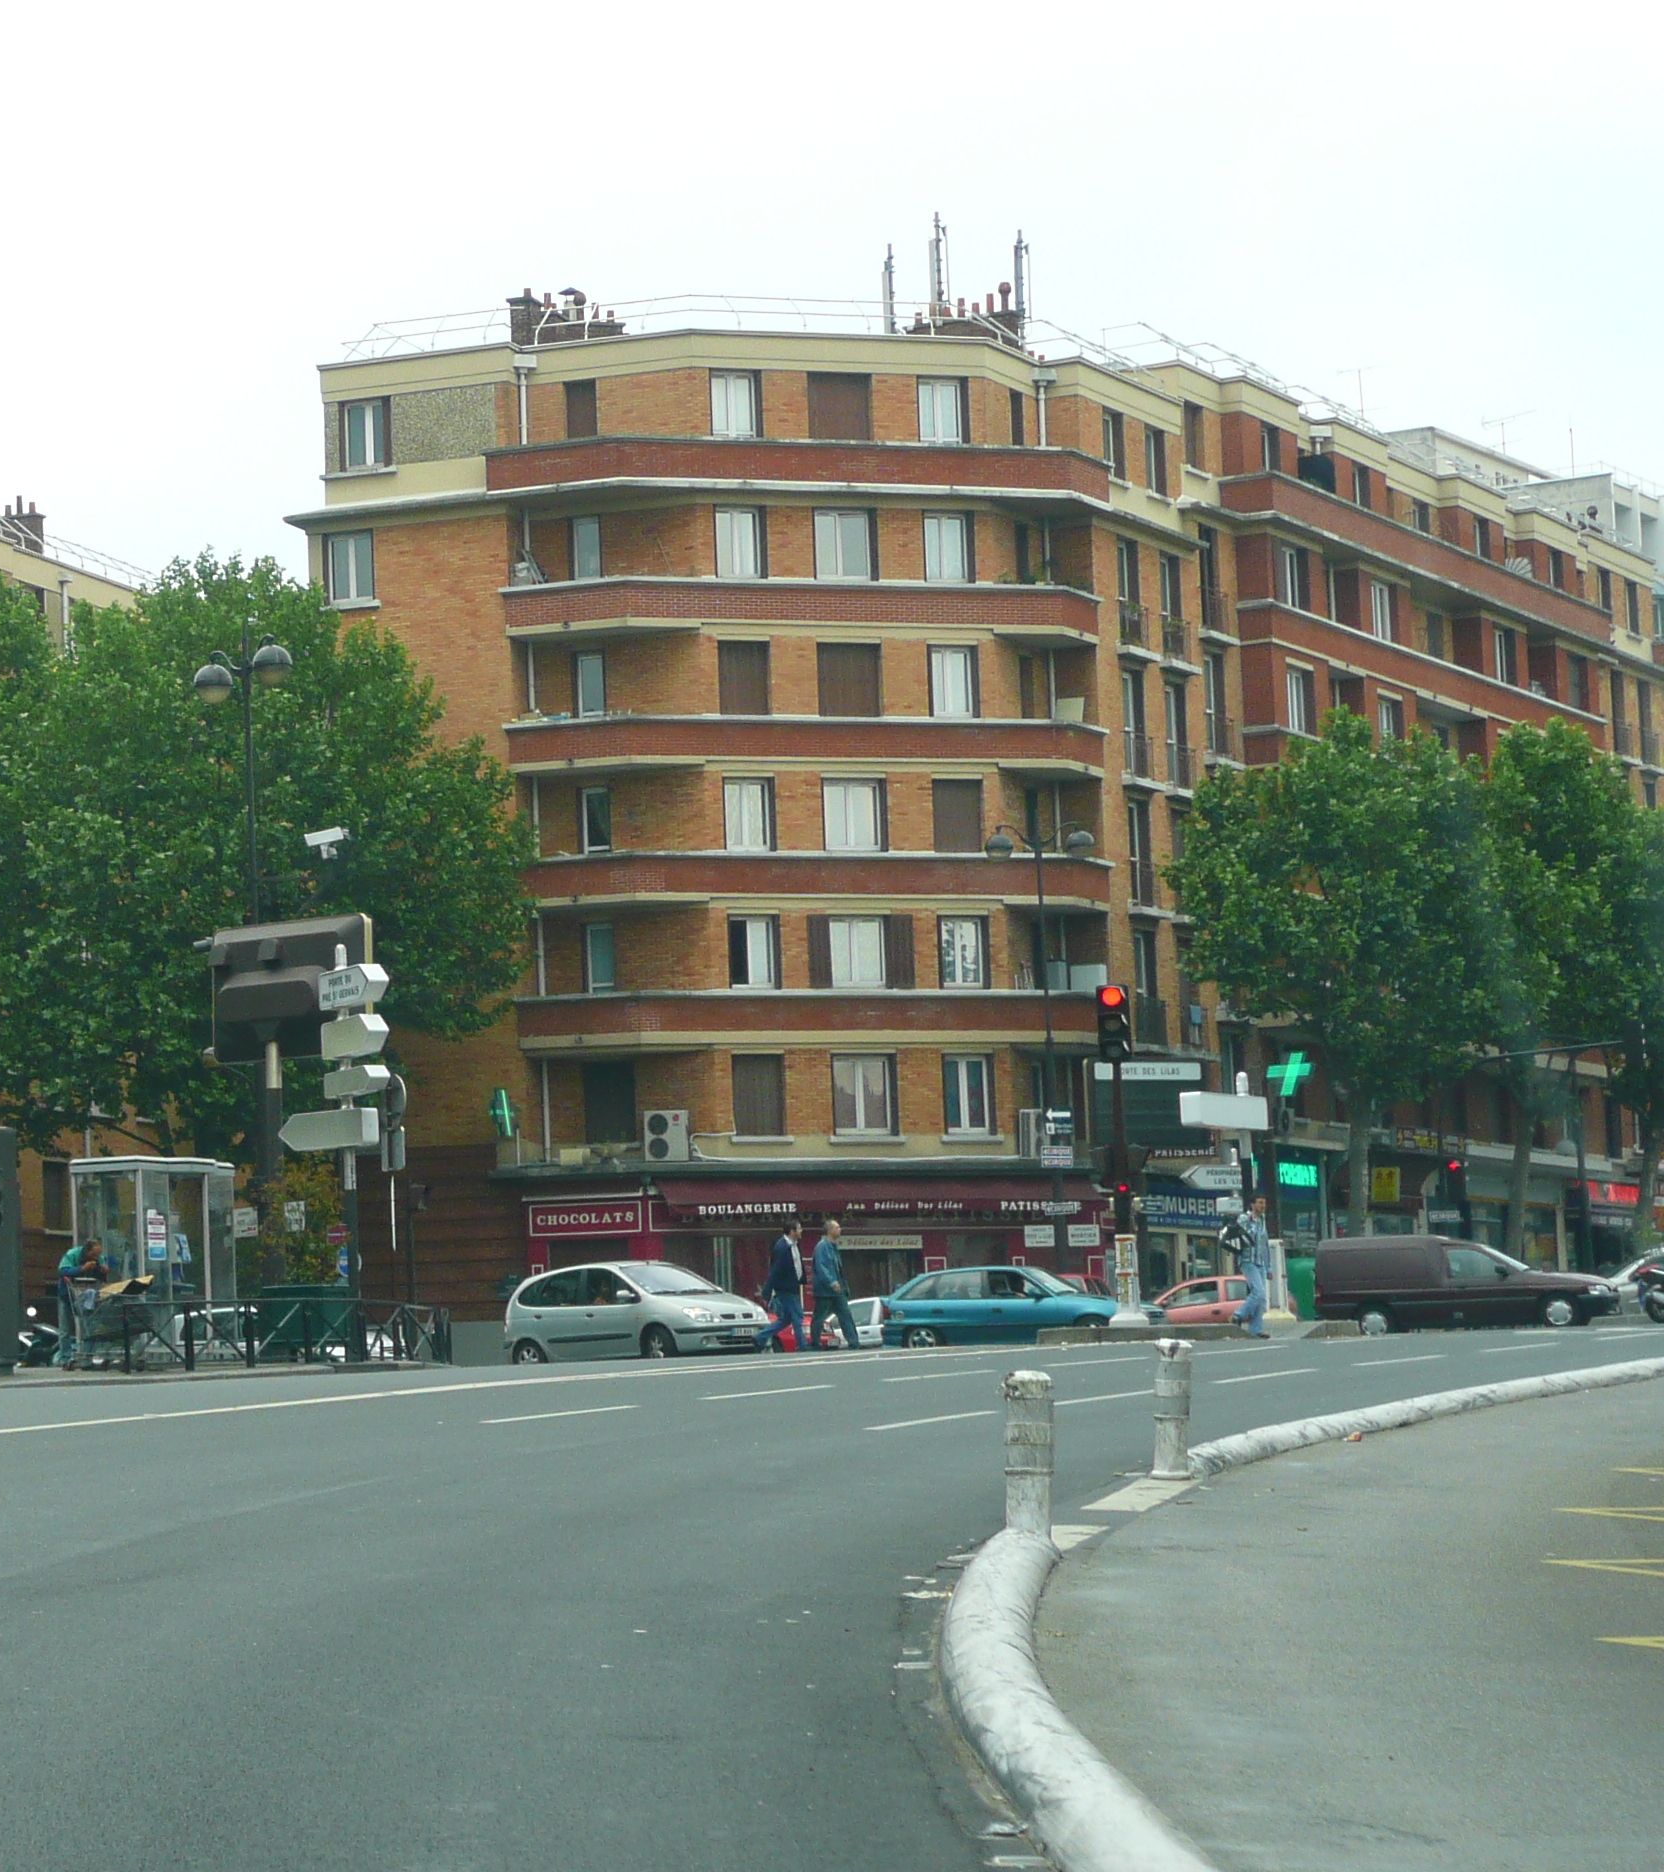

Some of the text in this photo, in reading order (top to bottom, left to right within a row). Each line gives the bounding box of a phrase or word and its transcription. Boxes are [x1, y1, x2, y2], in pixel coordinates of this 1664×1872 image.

[339, 985, 359, 998] GERVAIS
[1121, 1067, 1180, 1076] ORTE DES LILAS
[698, 1203, 797, 1215] BOULANGERIE
[937, 1200, 963, 1209] Lilas
[536, 1211, 634, 1226] CHOCOLATS
